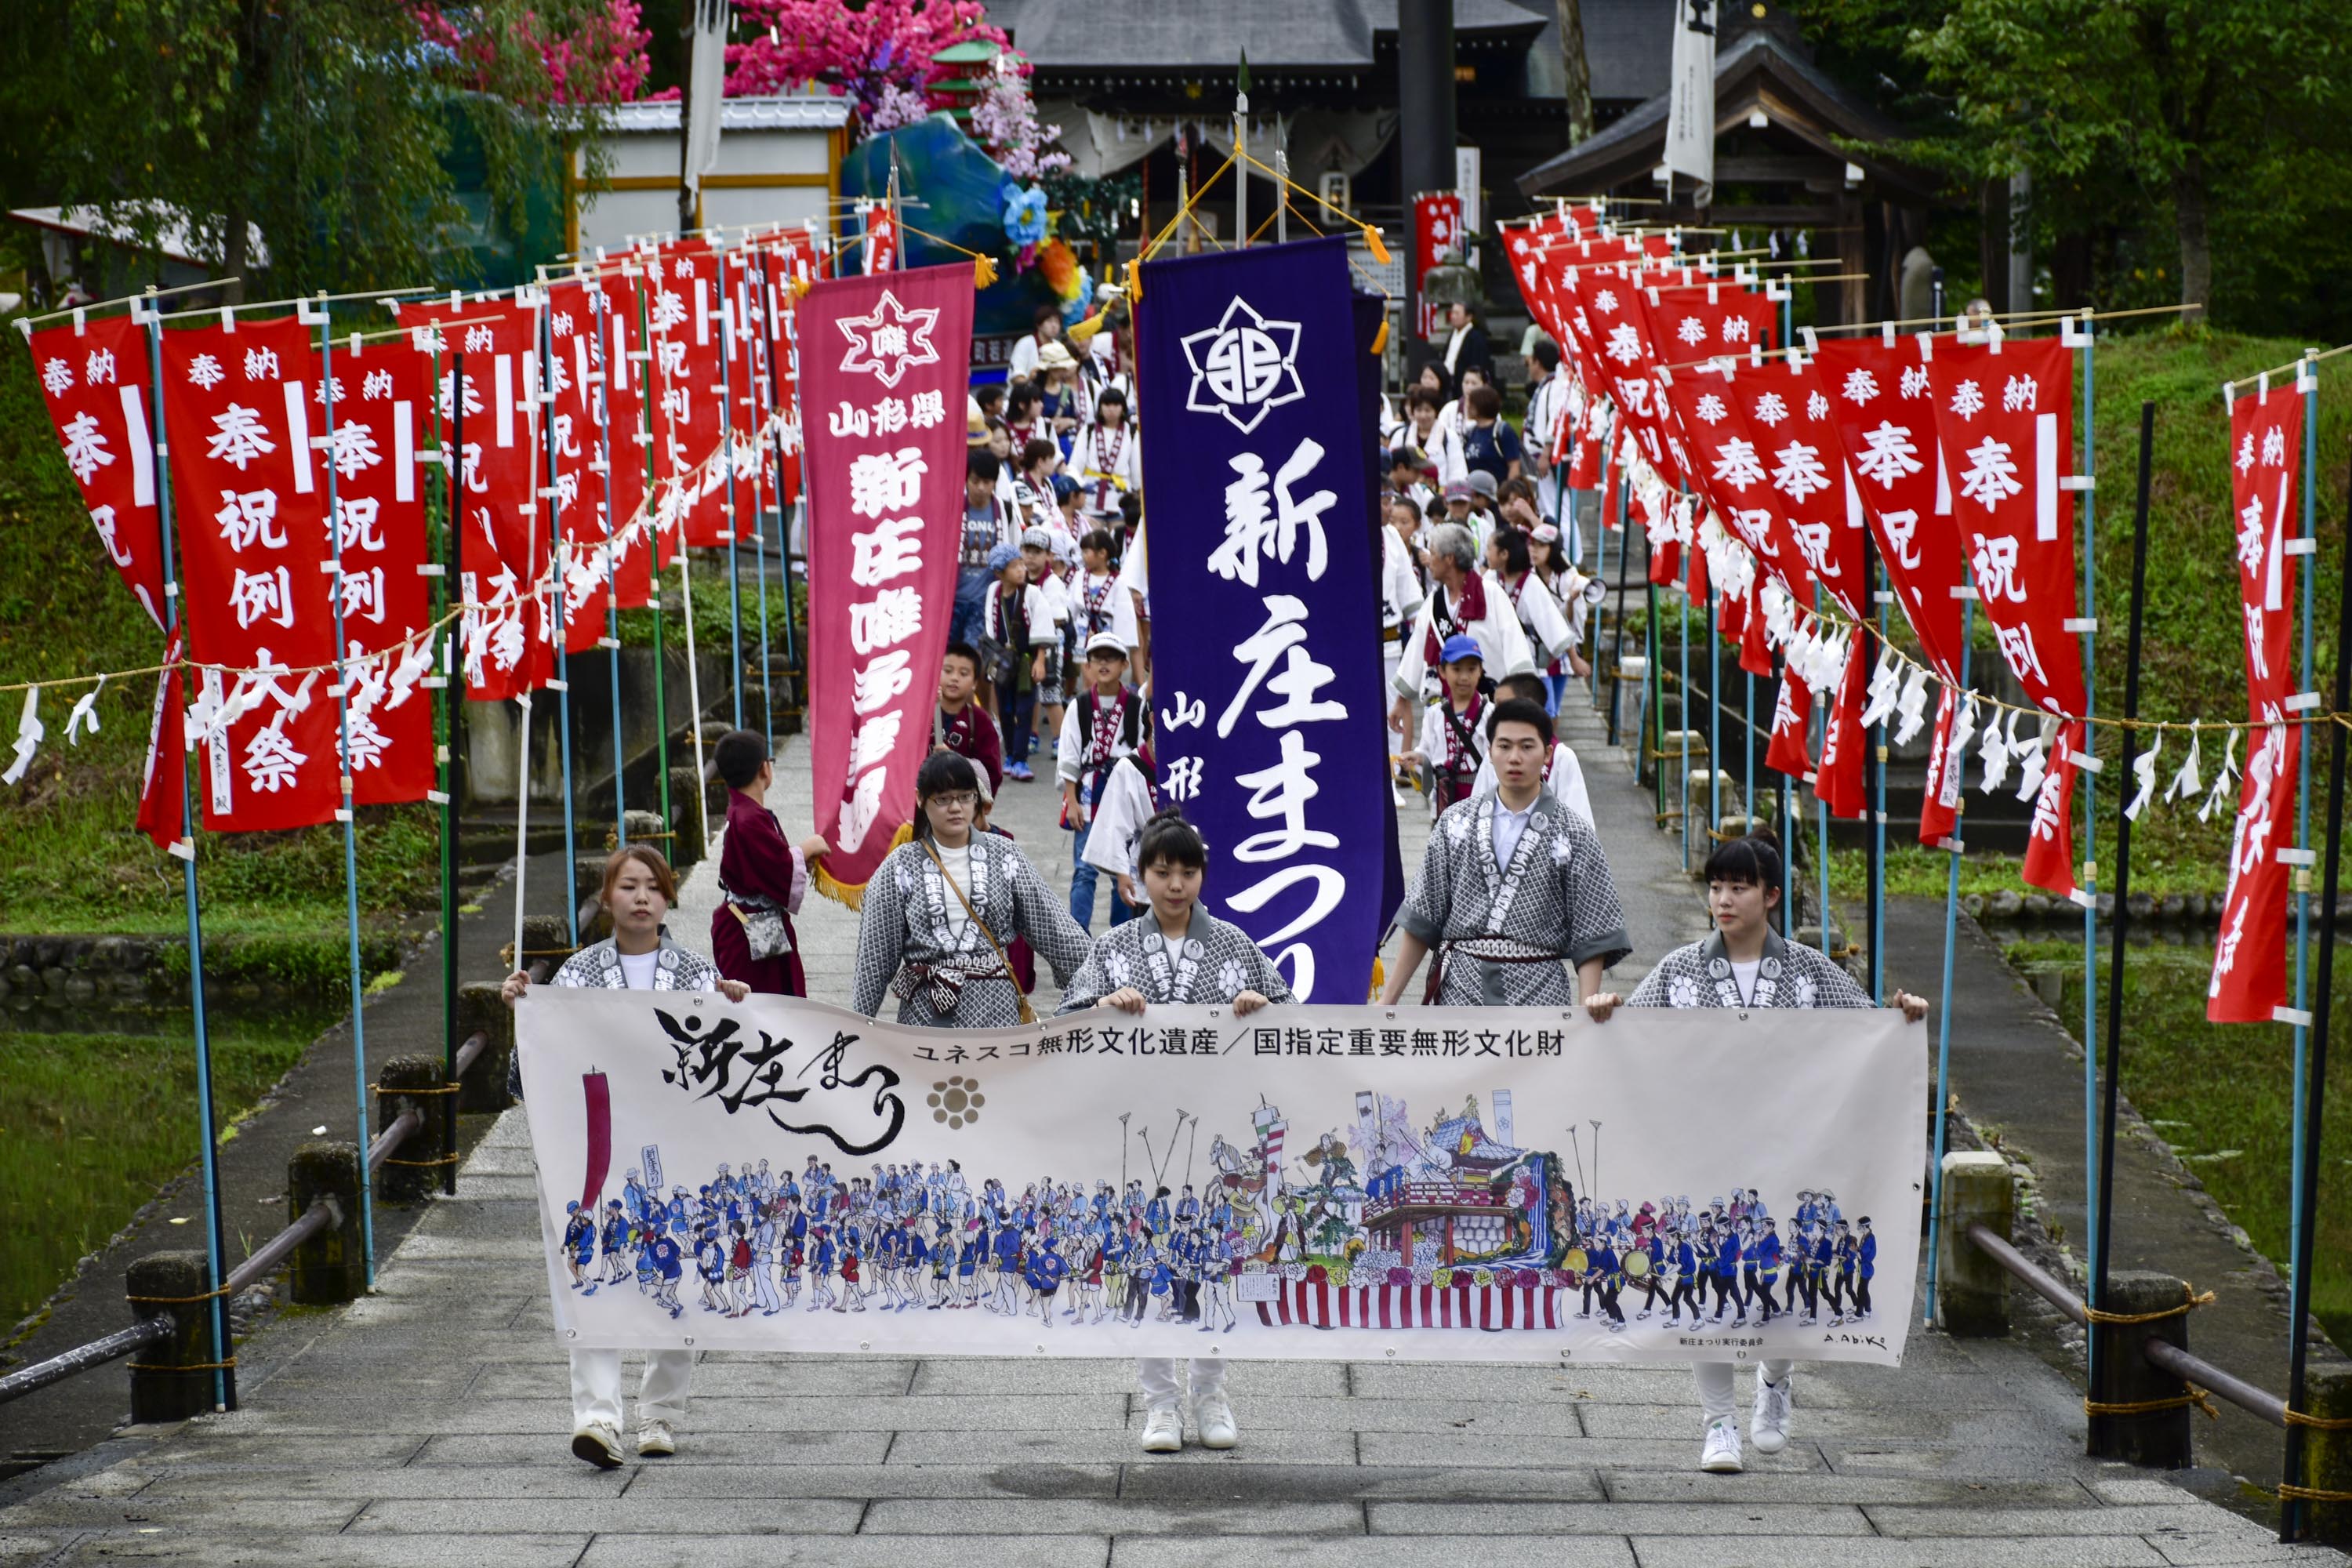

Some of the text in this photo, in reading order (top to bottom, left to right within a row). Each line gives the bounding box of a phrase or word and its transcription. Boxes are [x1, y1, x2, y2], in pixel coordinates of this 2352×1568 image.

[1677, 315, 1749, 347] 奉納
[42, 347, 117, 400] 奉納
[188, 346, 281, 392] 奉納
[314, 368, 394, 405] 奉納
[826, 389, 946, 439] 山形県
[1949, 373, 2038, 423] 奉納
[2234, 424, 2285, 478] 奉納
[205, 401, 310, 793] 奉祝例大祭
[1207, 437, 1348, 1004] 新庄まつり
[652, 1007, 906, 1156] 新庄まつり
[1679, 1337, 1764, 1348] 新庄まつり実行委員会
